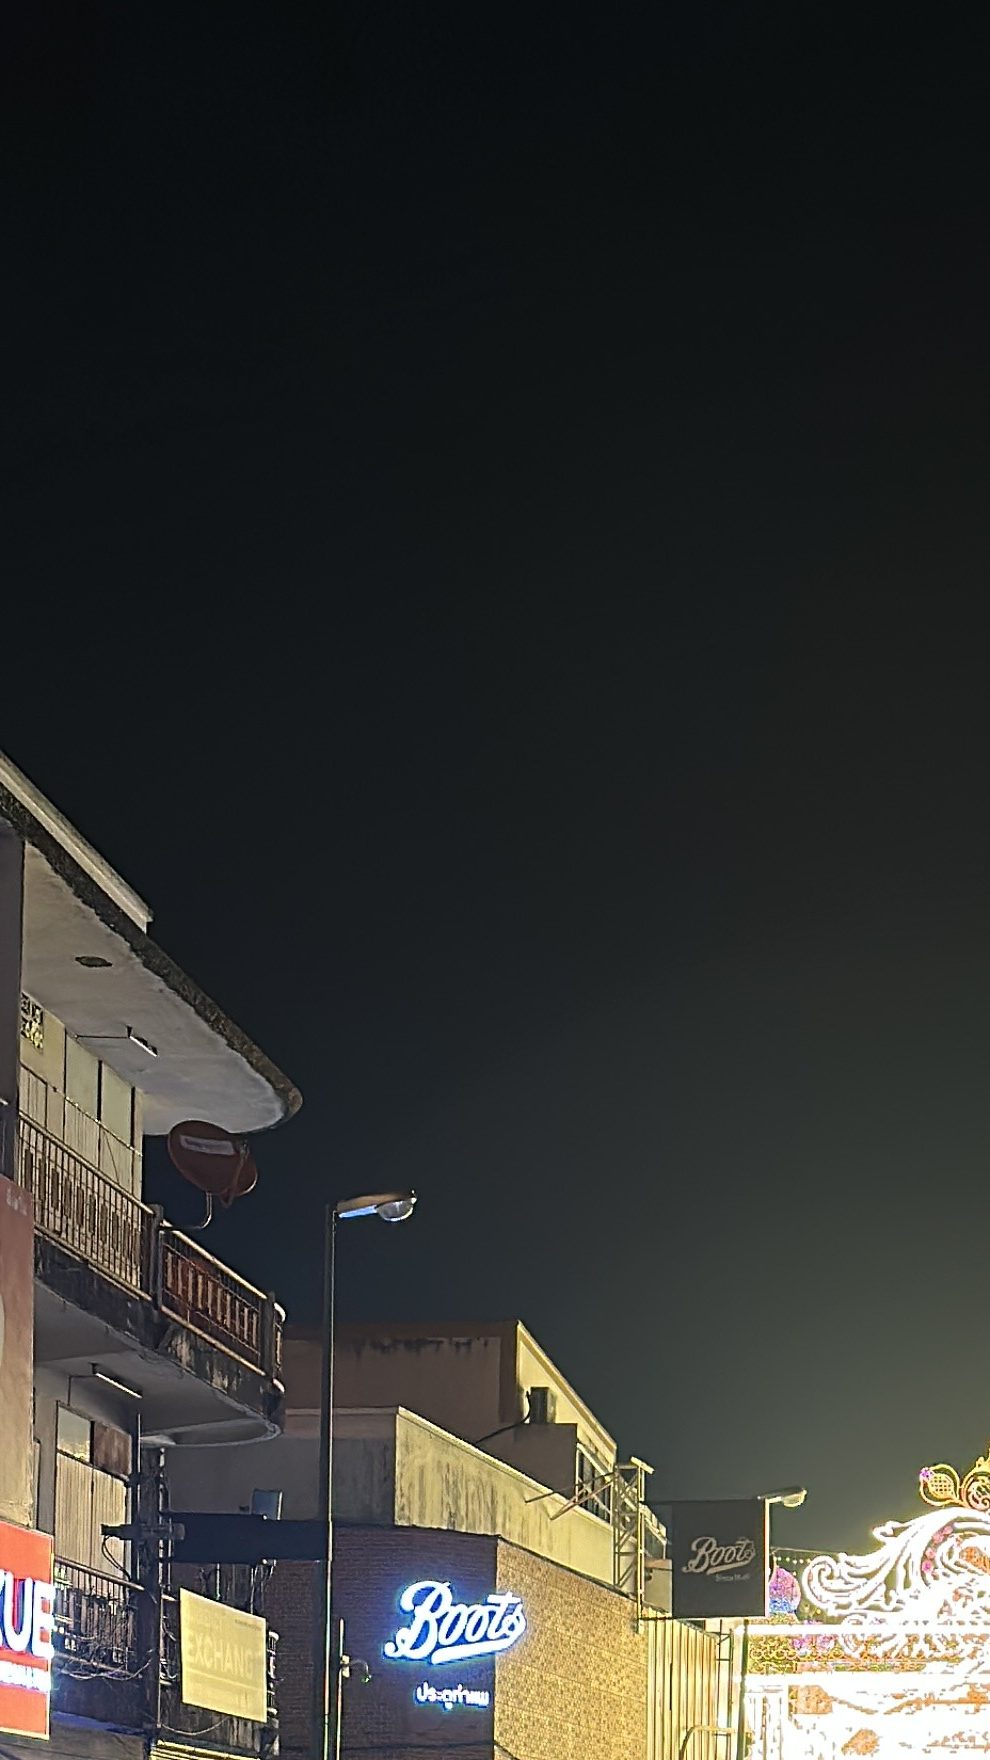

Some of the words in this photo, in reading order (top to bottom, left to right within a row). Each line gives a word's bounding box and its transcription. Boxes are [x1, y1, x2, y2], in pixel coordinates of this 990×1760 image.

[682, 1536, 756, 1576] Boots
[0, 1568, 54, 1658] UE
[384, 1579, 527, 1665] Boots
